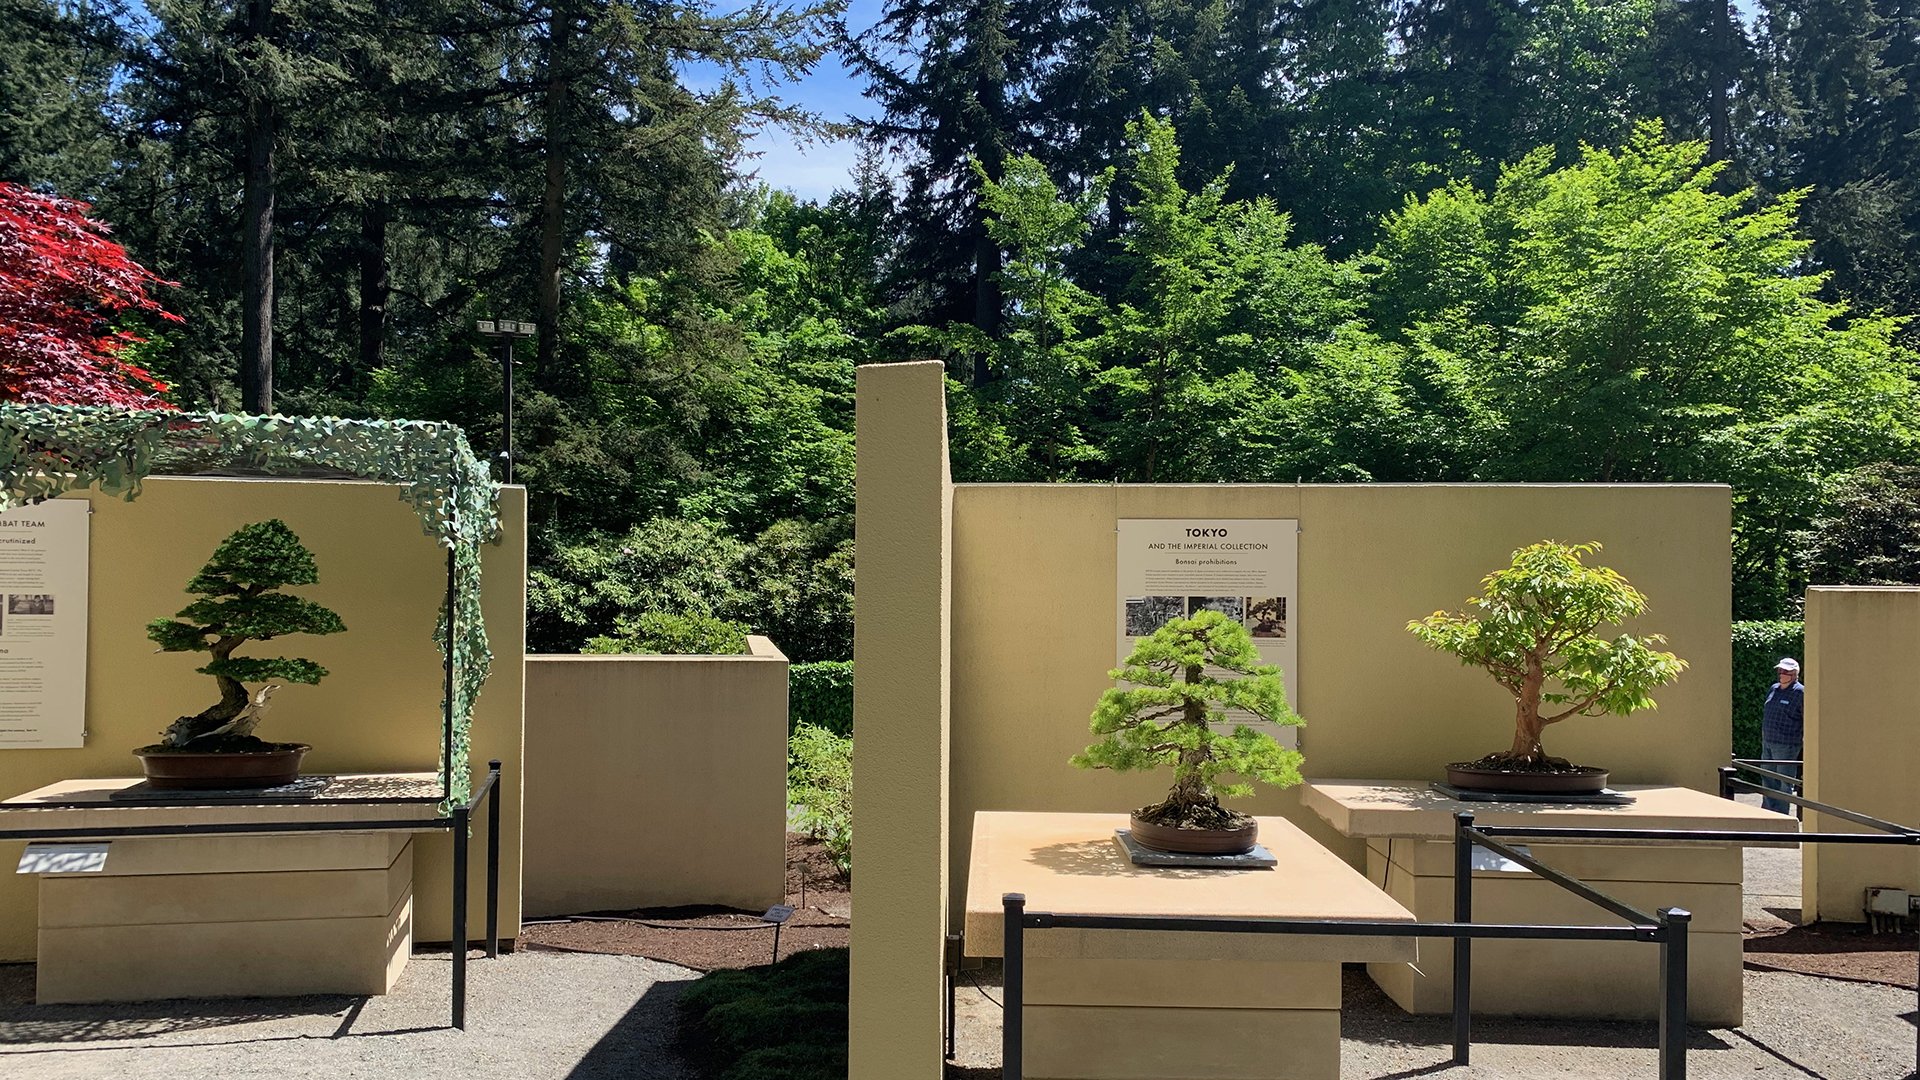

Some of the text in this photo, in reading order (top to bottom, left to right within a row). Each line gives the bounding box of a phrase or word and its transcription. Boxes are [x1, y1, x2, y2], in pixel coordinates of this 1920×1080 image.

[21, 520, 46, 528] TEAM
[1185, 528, 1228, 538] TOKYO
[1198, 558, 1238, 567] prohibitions
